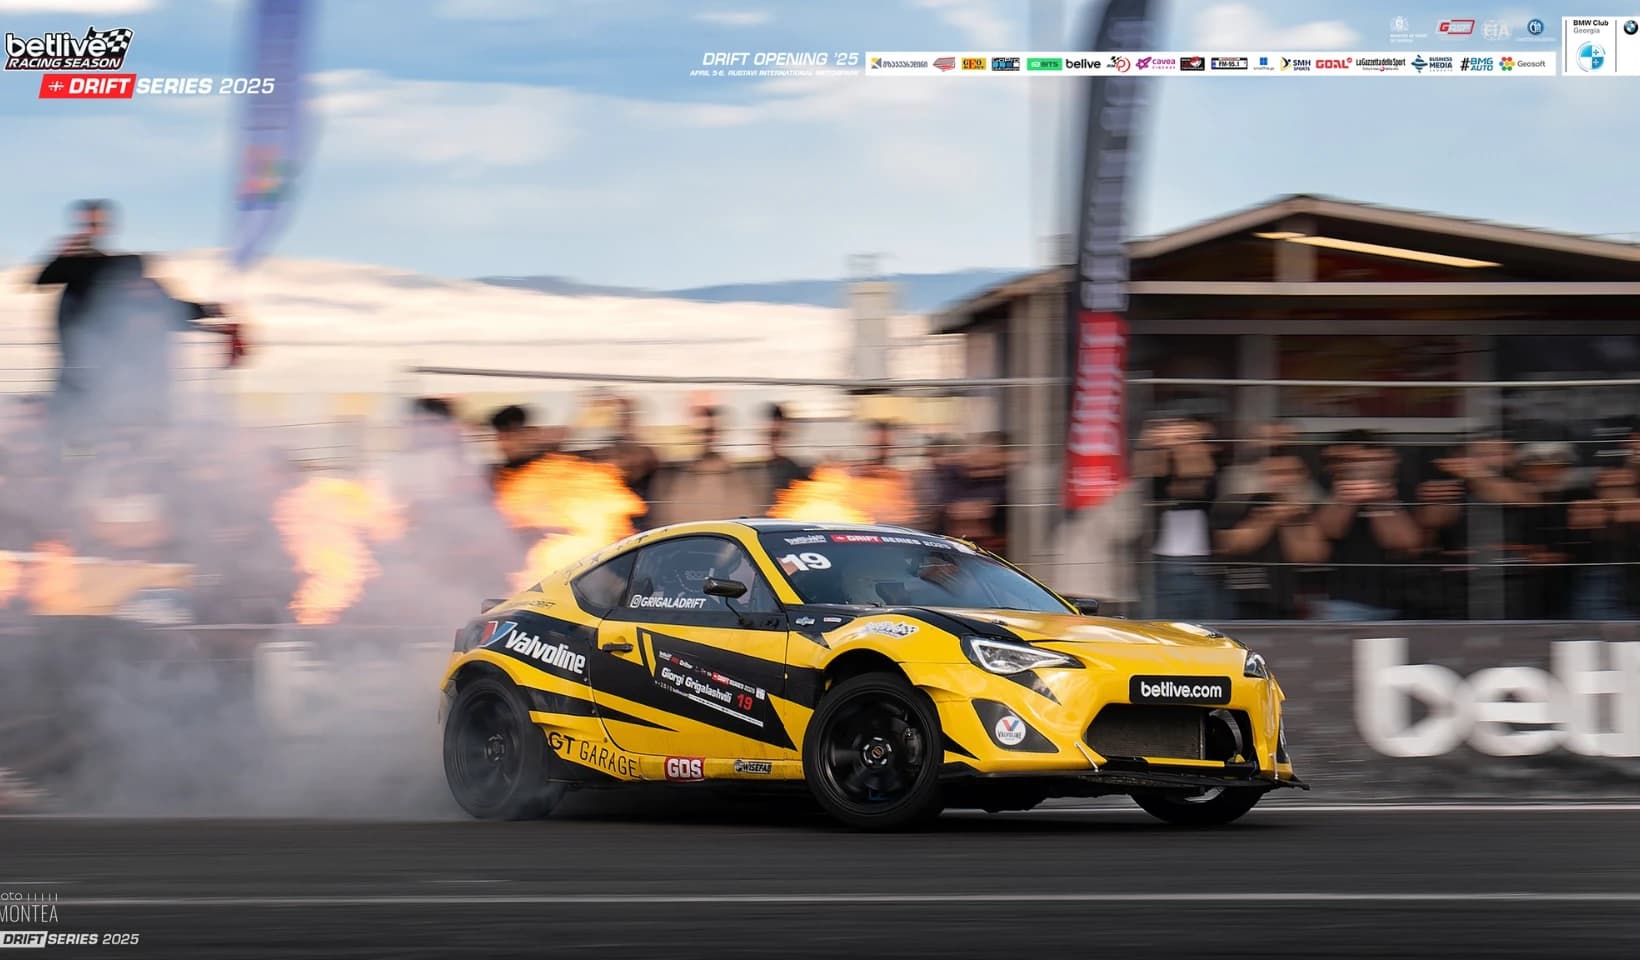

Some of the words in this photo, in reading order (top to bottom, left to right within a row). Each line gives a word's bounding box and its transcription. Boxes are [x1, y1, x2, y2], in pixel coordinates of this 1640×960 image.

[781, 552, 832, 571] 19
[505, 629, 586, 674] Valvoline
[661, 667, 685, 686] Giorgi
[1140, 681, 1222, 698] betlive.com
[737, 693, 753, 711] 19
[549, 731, 576, 754] GT
[580, 741, 642, 778] GARAGE
